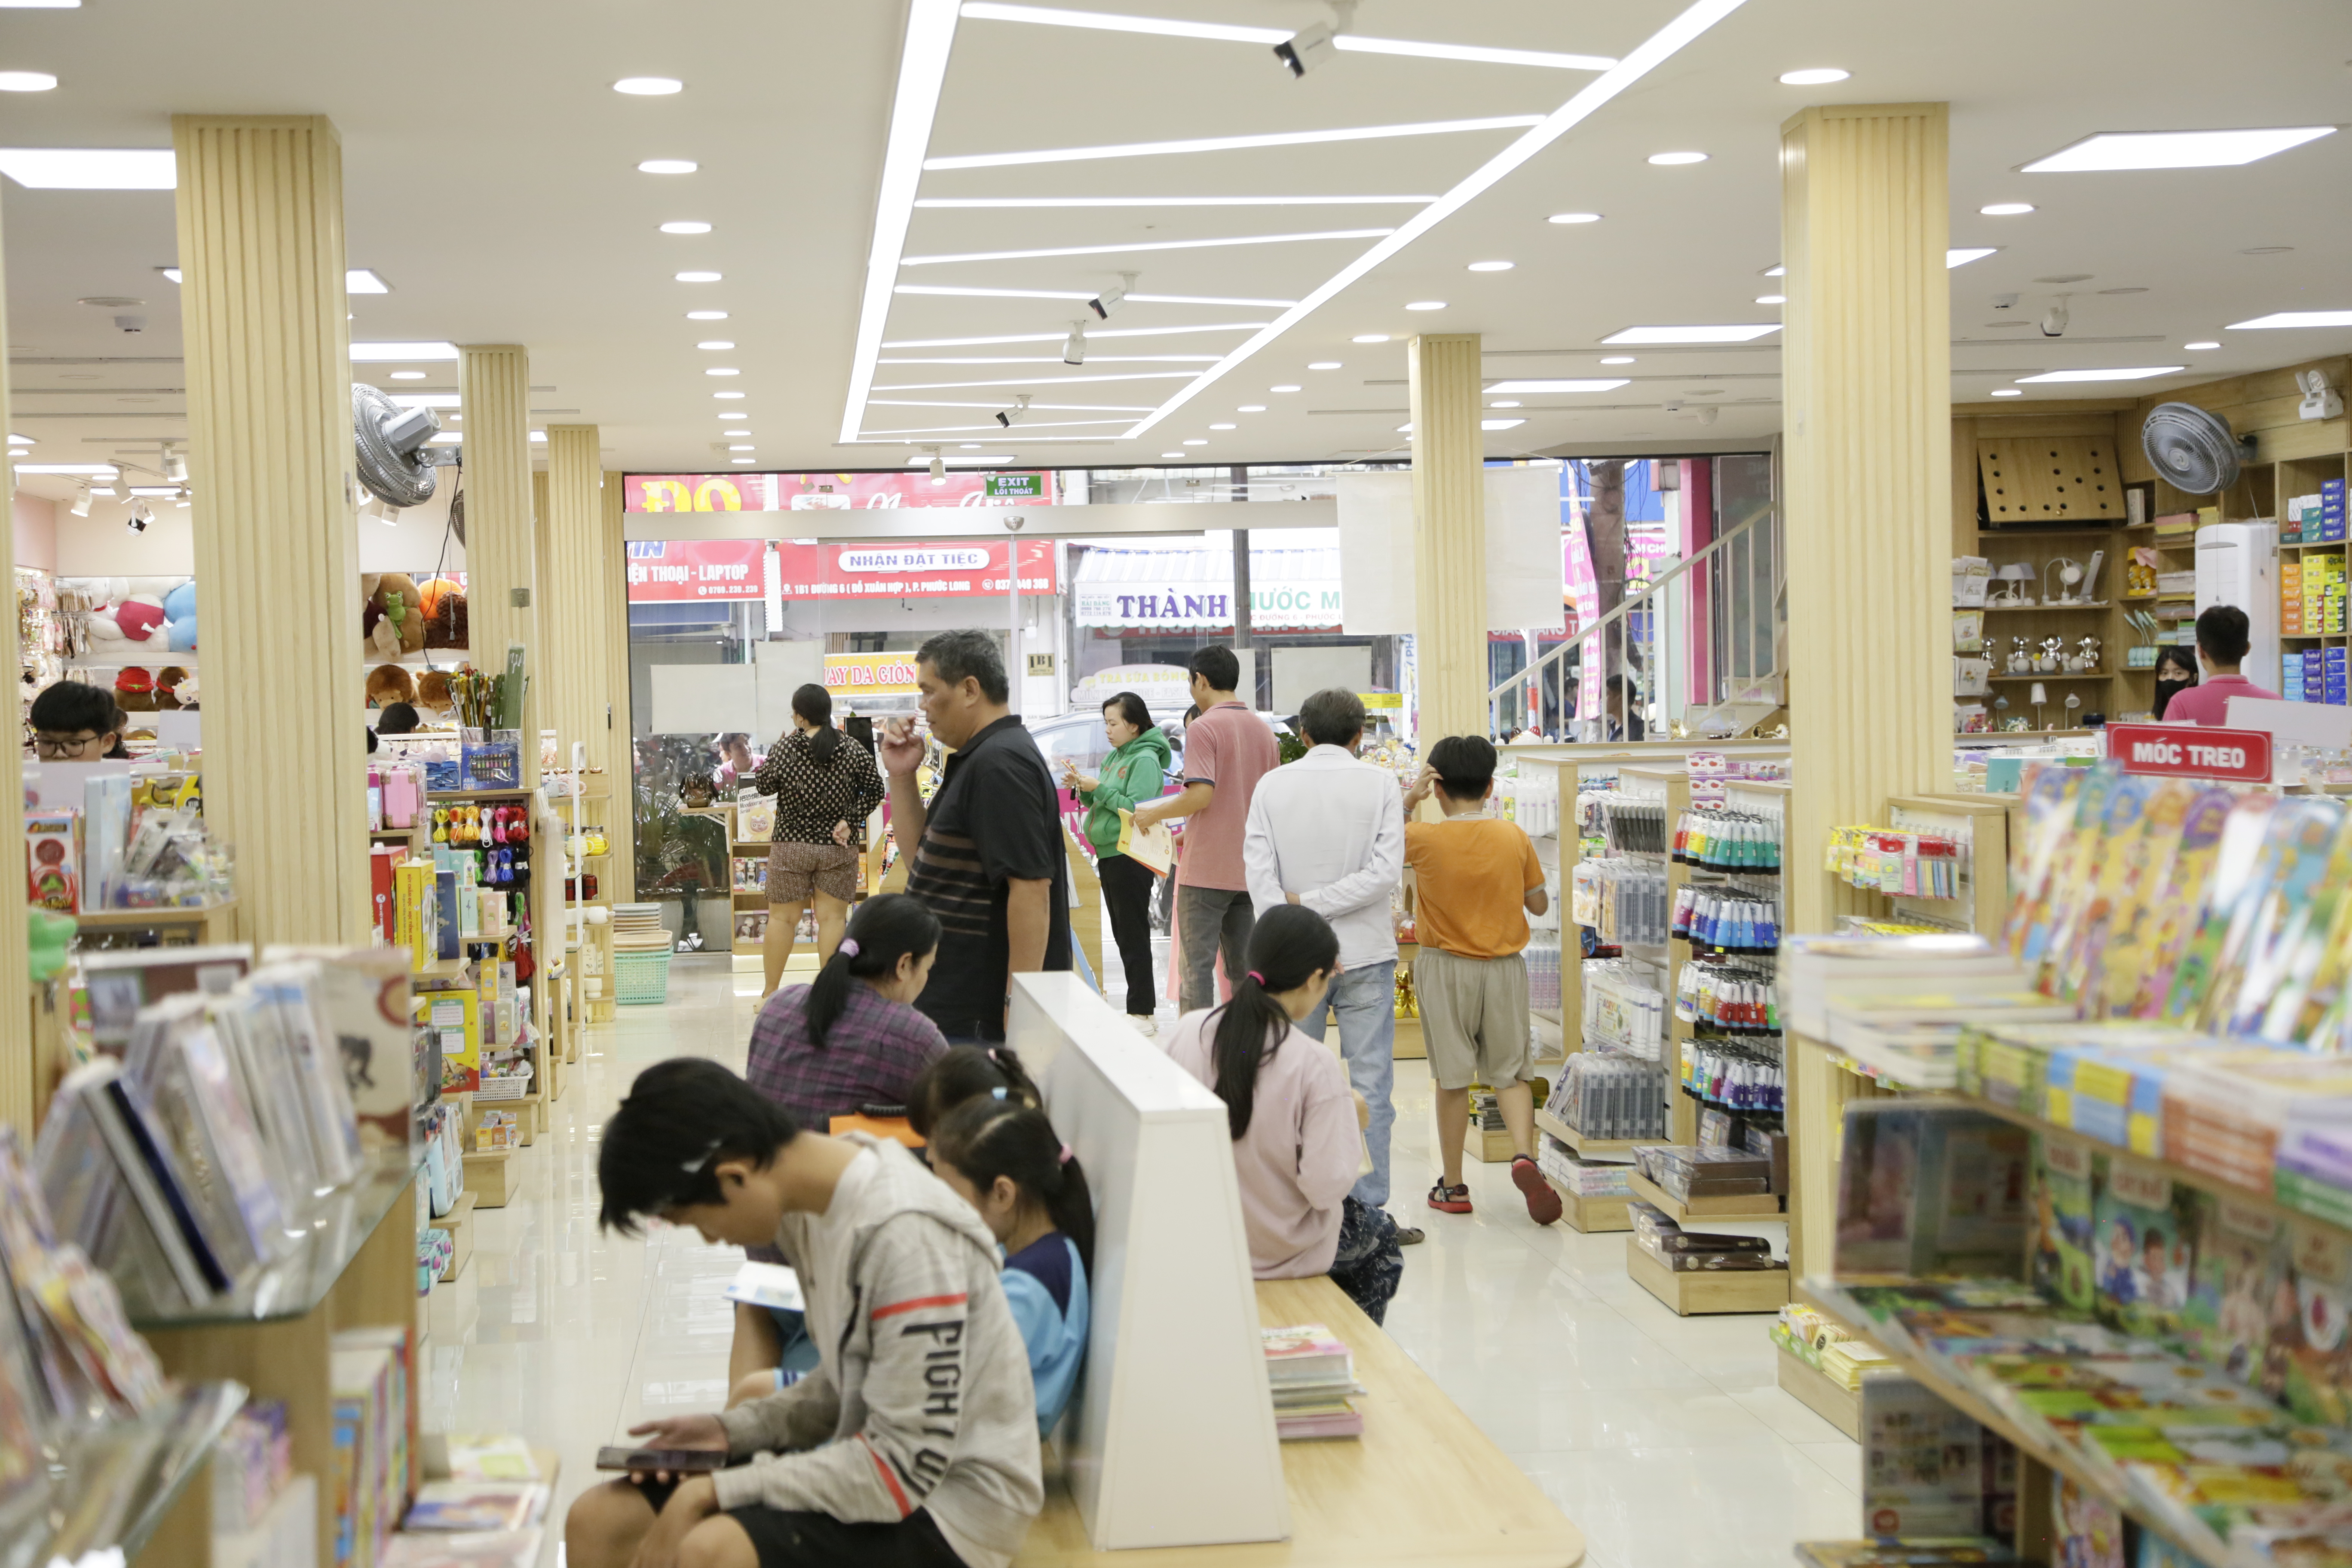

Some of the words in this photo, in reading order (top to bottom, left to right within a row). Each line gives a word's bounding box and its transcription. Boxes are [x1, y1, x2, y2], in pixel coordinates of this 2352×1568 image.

[998, 477, 1029, 486] EXIT
[1009, 487, 1033, 495] THOÁT
[1647, 542, 1666, 554] CH
[850, 553, 897, 568] NHẬN
[904, 552, 935, 567] ĐẶT
[942, 552, 978, 567] TIỆC
[628, 562, 648, 585] IỆN
[651, 565, 689, 585] THOẠI
[698, 564, 749, 581] LAPTOP
[794, 584, 809, 594] 1B1
[839, 583, 845, 593] 6
[864, 581, 887, 593] XUÂN
[921, 579, 948, 592] PHƯỚC
[949, 581, 971, 591] LONG
[1117, 588, 1228, 618] THÀNH
[851, 665, 876, 684] DA
[877, 659, 917, 684] GIÒN
[2133, 737, 2182, 765] MÓC
[2186, 745, 2246, 769] TREO
